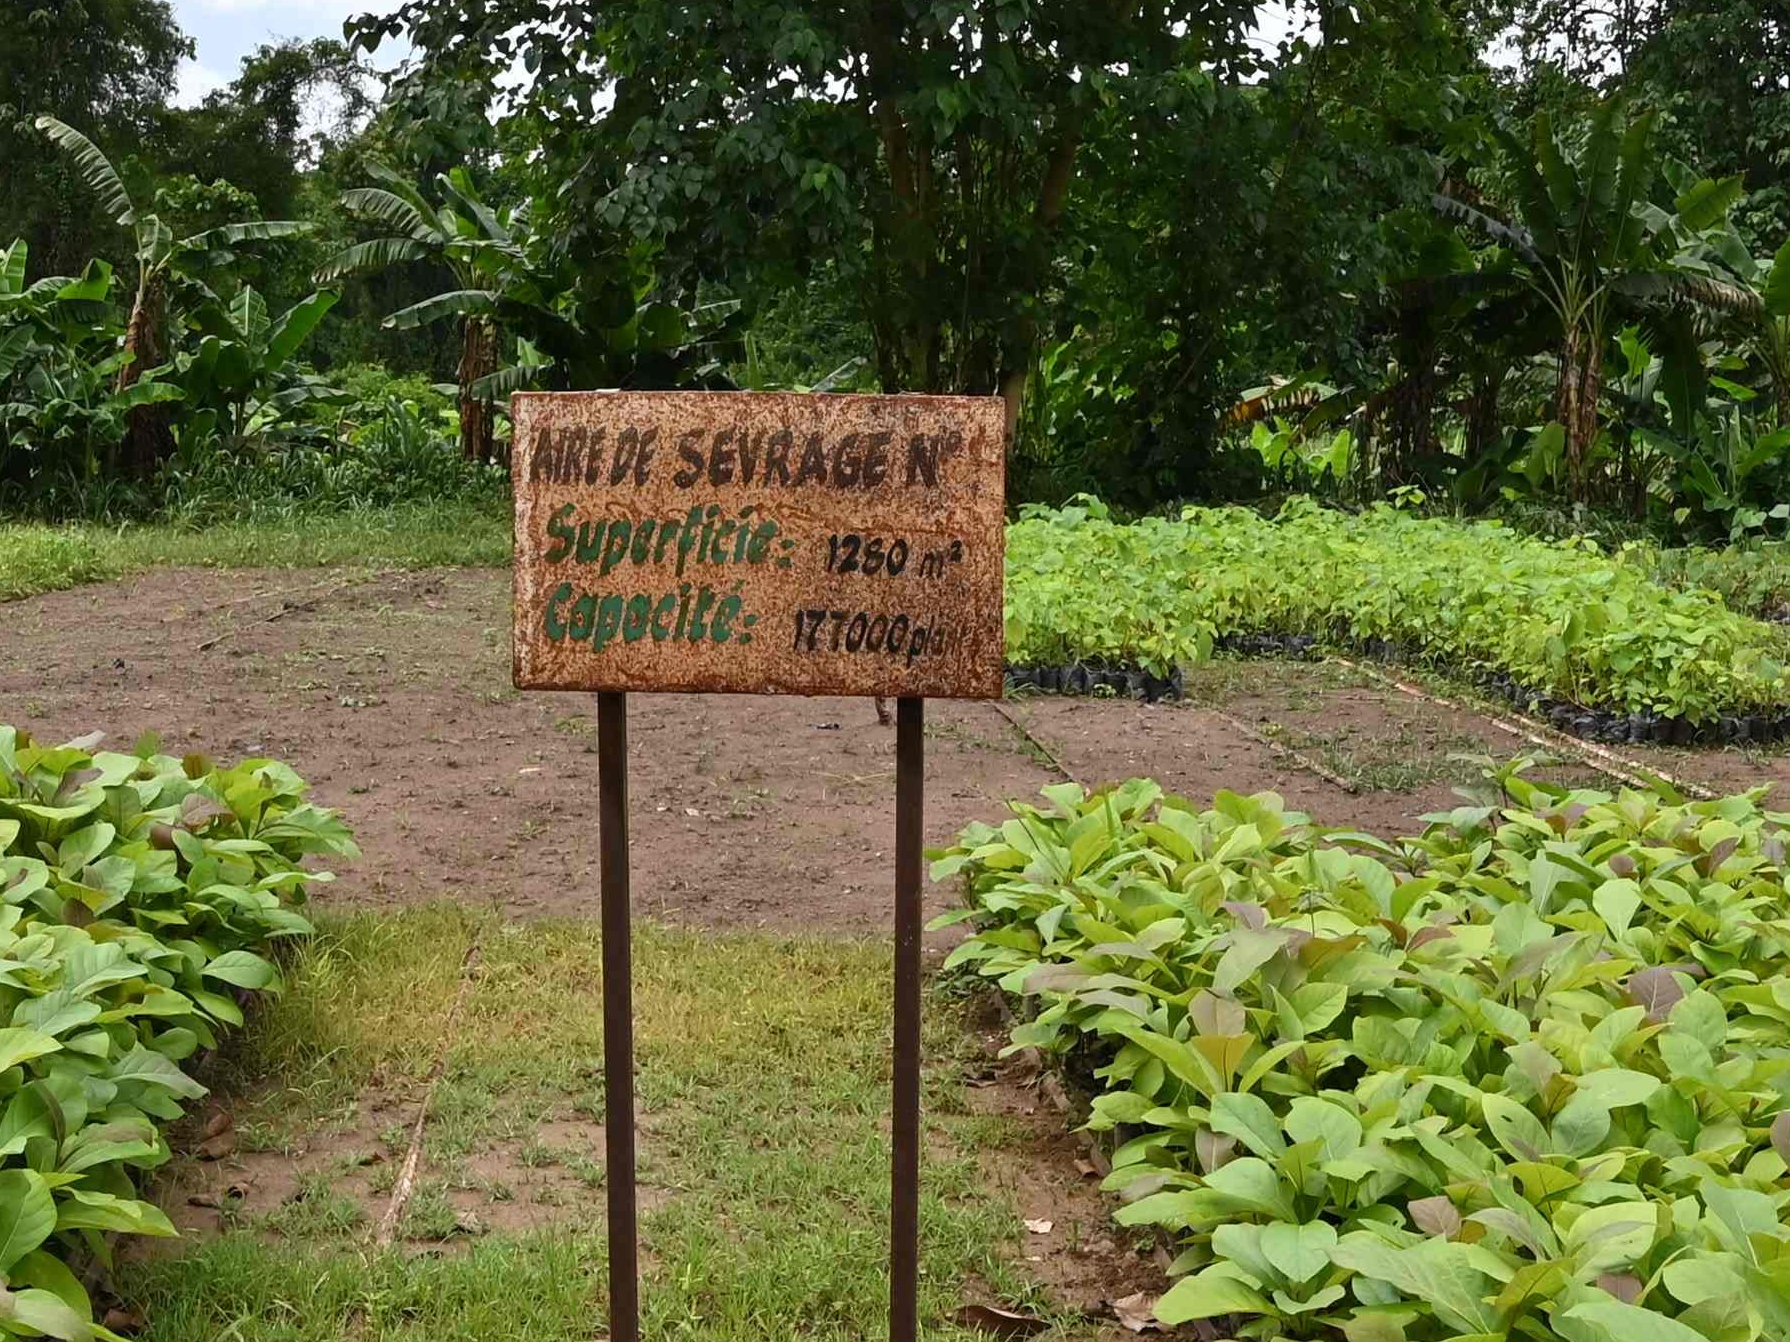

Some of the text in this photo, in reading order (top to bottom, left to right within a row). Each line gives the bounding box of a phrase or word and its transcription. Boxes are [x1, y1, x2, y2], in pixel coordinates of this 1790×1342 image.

[530, 426, 606, 485] AIRE
[610, 425, 659, 487] DE
[672, 425, 893, 490] SEVRAGE
[544, 502, 796, 578] Superficie:
[544, 581, 758, 654] Capacité:
